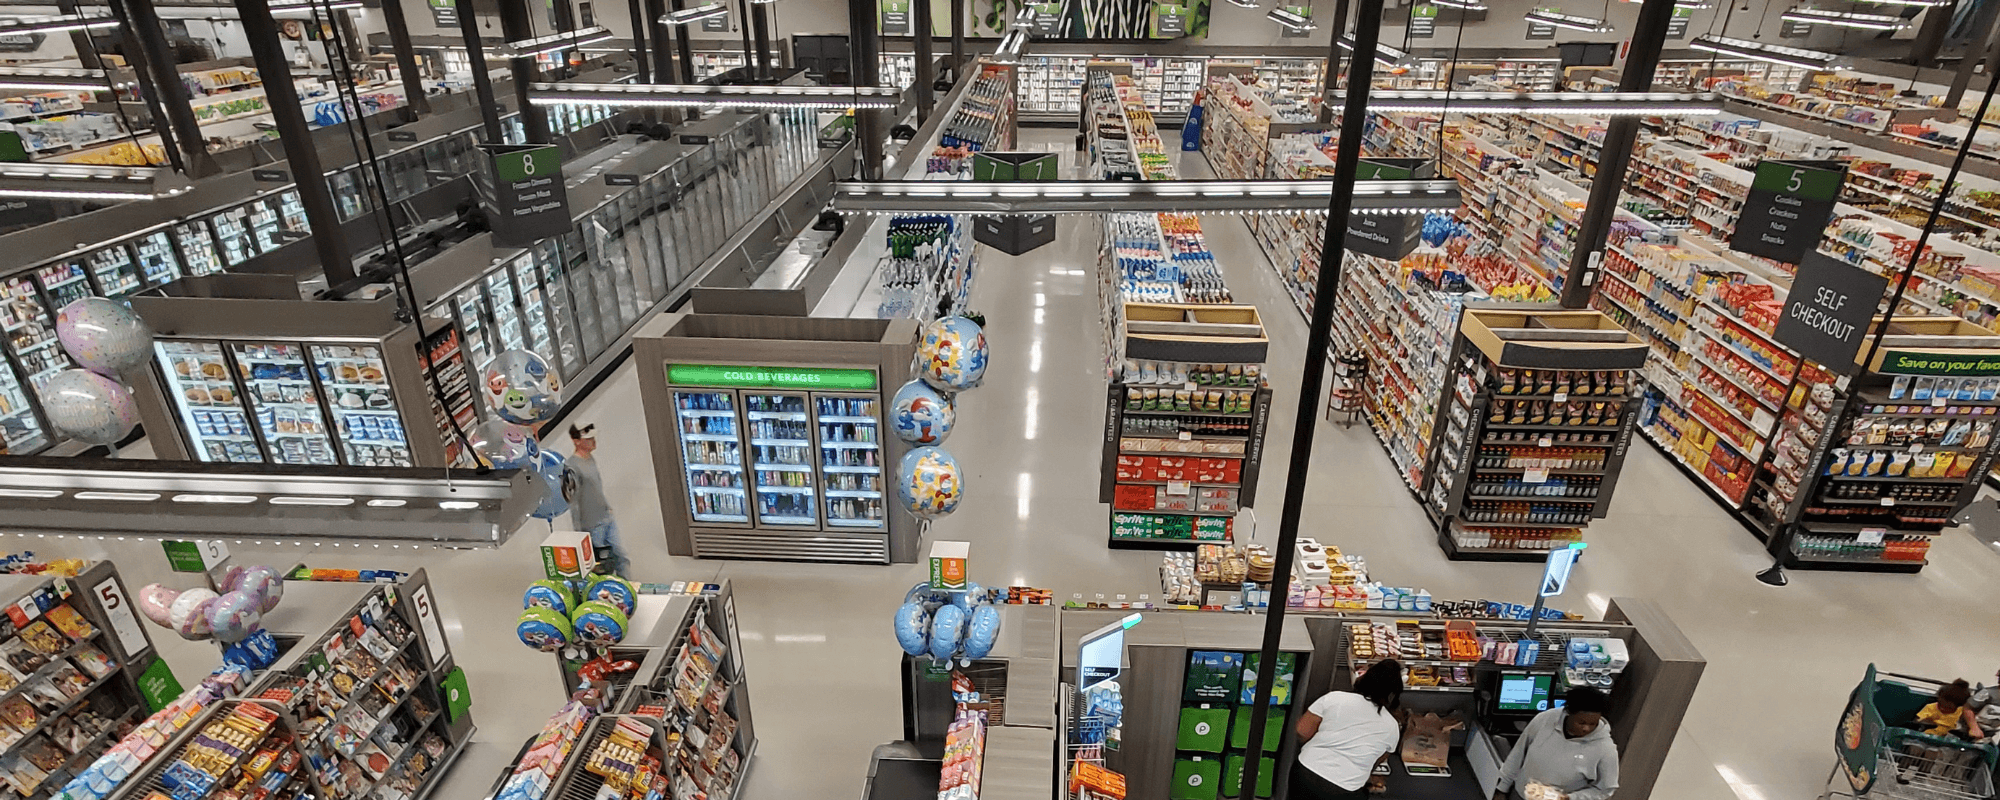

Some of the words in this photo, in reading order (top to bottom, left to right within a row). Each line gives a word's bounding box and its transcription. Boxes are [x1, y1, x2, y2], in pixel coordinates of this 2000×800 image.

[1674, 8, 1681, 17] 2
[523, 154, 535, 175] 8
[989, 161, 997, 180] 7
[1035, 161, 1043, 180] 7
[1786, 169, 1806, 192] 5
[1768, 206, 1799, 220] Crackers
[1372, 232, 1389, 244] Drinks
[1761, 233, 1785, 245] Snacks
[1769, 221, 1788, 232] Nuts
[1814, 286, 1848, 311] SELF
[1791, 302, 1856, 342] CHECKOUT
[723, 371, 753, 381] COLD
[757, 372, 821, 383] BEVERAGES
[1897, 356, 1928, 368] Save
[1929, 360, 1946, 369] on
[1945, 361, 1977, 373] your
[1107, 398, 1117, 442] GUARANTEED
[1465, 408, 1480, 444] CHECKOUT
[1615, 411, 1636, 456] GUARANTEED
[1250, 438, 1261, 466] SERVICE
[1458, 445, 1471, 474] PROMISE
[543, 547, 557, 577] EXPRESS
[932, 558, 940, 588] EXPRESS
[101, 585, 120, 610] 5
[417, 593, 429, 618] 5
[727, 604, 734, 629] 5
